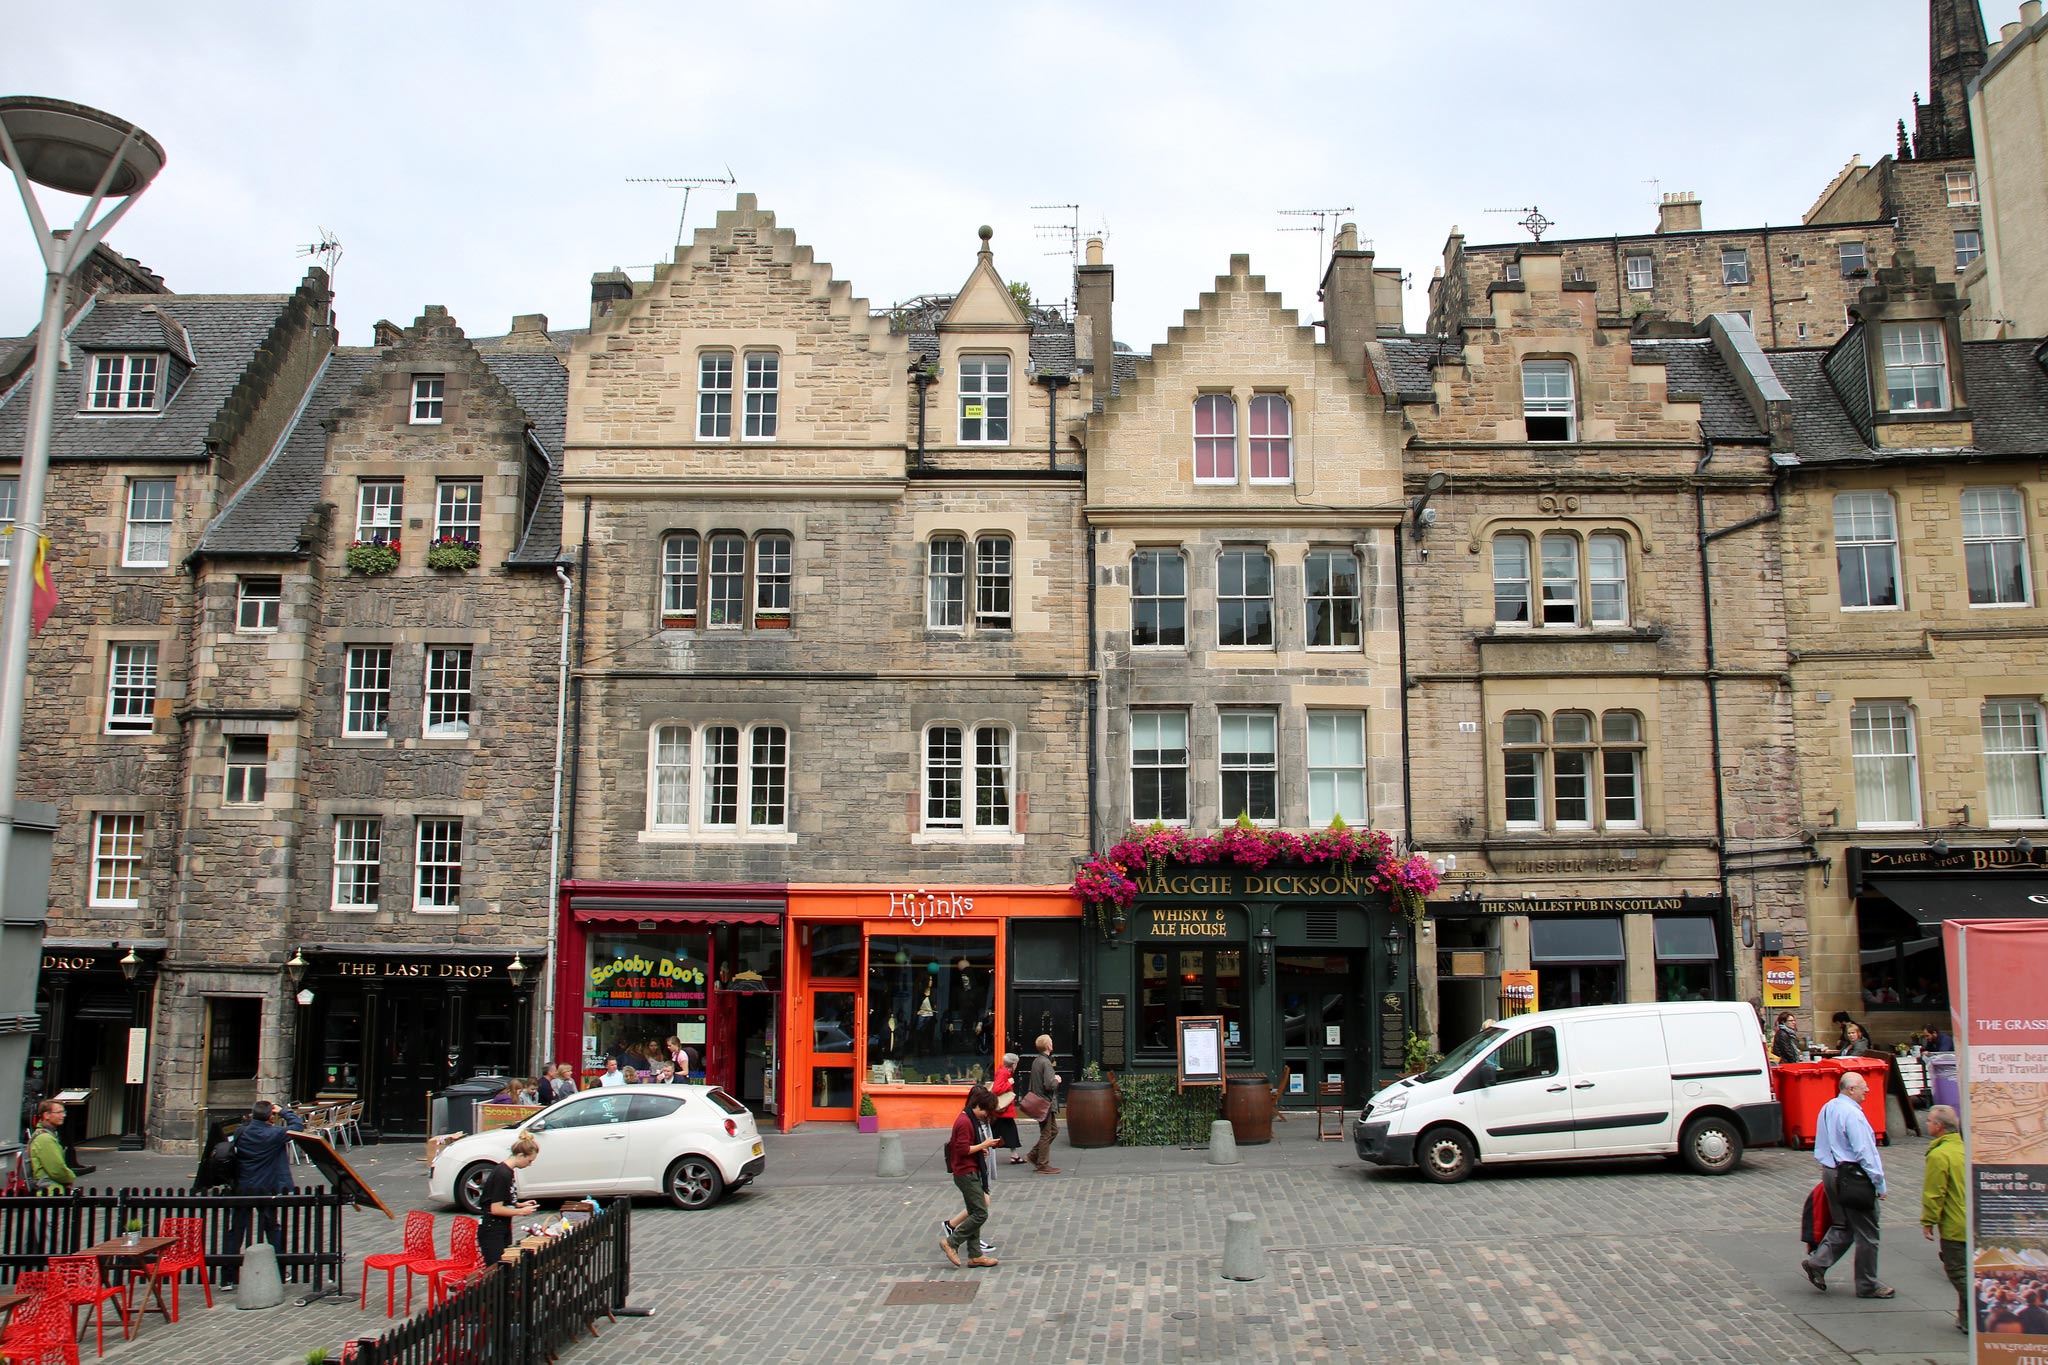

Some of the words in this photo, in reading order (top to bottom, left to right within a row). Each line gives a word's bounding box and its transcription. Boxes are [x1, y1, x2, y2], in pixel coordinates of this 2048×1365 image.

[1515, 859, 1585, 874] MISSION
[1934, 854, 1966, 867] STOUT
[1971, 850, 2034, 870] BIDDY
[1134, 876, 1232, 895] MAGGIE
[1244, 876, 1376, 896] DICKSON'S
[888, 888, 974, 927] Hijinks
[1479, 902, 1507, 913] THE
[1507, 901, 1572, 912] SMALLEST
[1574, 901, 1598, 911] PUB
[1600, 901, 1614, 910] IN
[1615, 899, 1682, 910] SCOTLAND
[1151, 909, 1208, 922] WHISKY
[1215, 909, 1225, 921] &
[1150, 923, 1176, 936] ALE
[1180, 923, 1227, 937] HOUSE
[42, 956, 96, 970] DROP
[338, 962, 376, 976] THE
[384, 963, 432, 977] LAST
[438, 964, 493, 977] DROP
[589, 954, 655, 985] Scooby
[658, 958, 705, 985] Doo's
[1766, 970, 1795, 978] free
[616, 977, 646, 988] CAFE
[650, 977, 674, 988] BAR
[634, 991, 646, 999] HOT
[666, 1000, 689, 1008] DRINKS
[1976, 1019, 2003, 1031] THE
[2004, 1019, 2048, 1030] GRASS
[1978, 1052, 1996, 1062] Get
[1998, 1053, 2021, 1065] your
[1978, 1064, 2005, 1074] Time
[484, 1106, 517, 1118] Scooby
[1980, 1171, 2014, 1180] Discover
[2015, 1171, 2029, 1180] the
[1980, 1181, 2004, 1190] Heart
[2005, 1182, 2014, 1190] of
[2015, 1181, 2029, 1190] the
[2029, 1181, 2047, 1193] City
